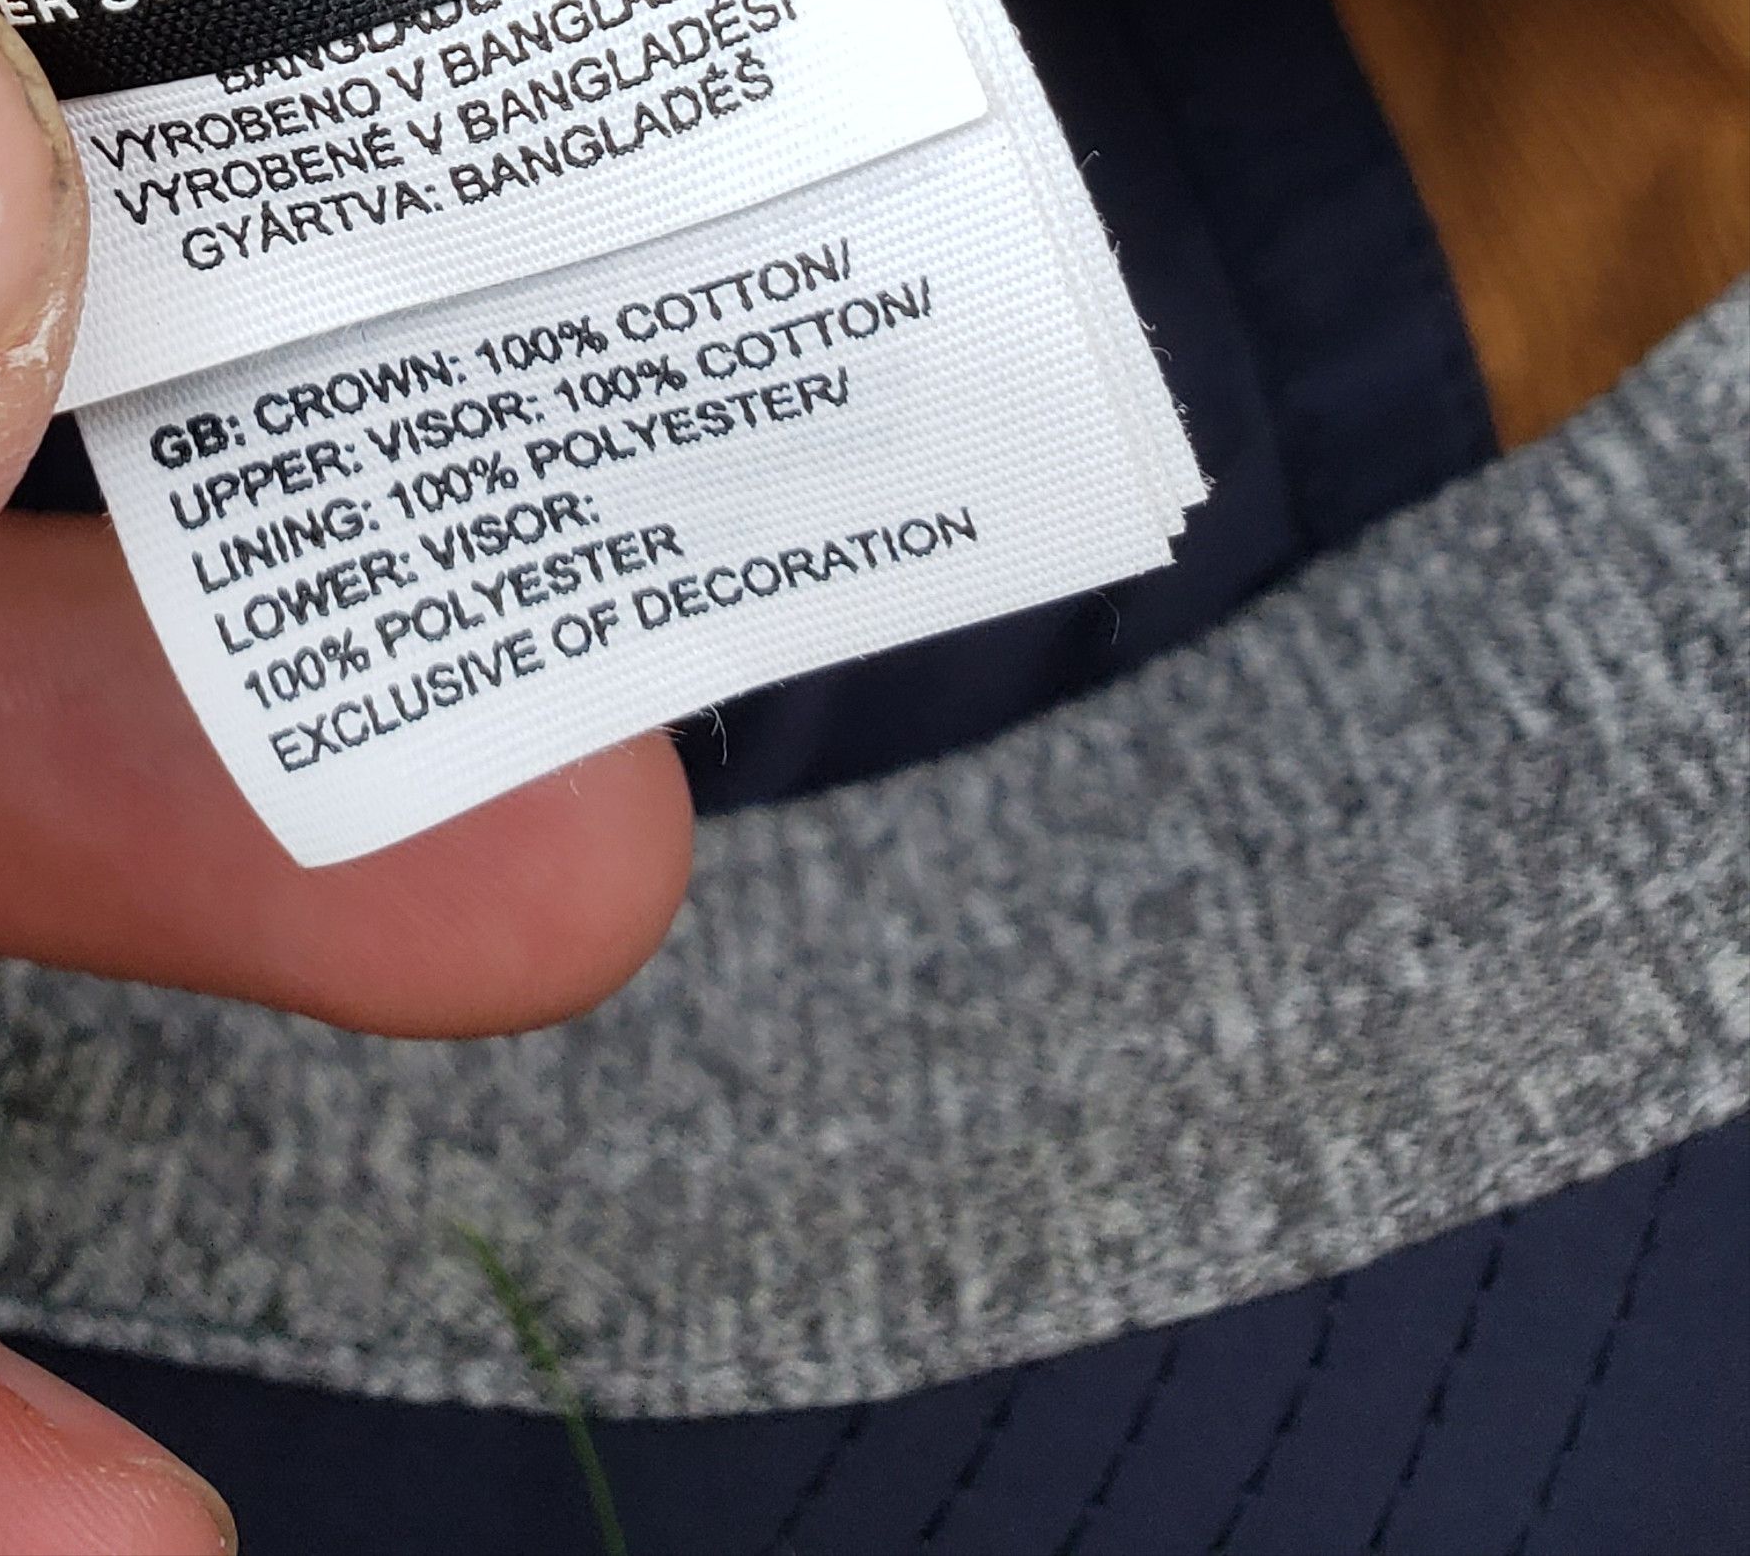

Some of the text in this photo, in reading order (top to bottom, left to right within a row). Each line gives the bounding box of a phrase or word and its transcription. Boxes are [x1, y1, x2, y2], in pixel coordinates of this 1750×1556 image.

[91, 76, 382, 170] VYROBENO
[387, 55, 427, 102] V
[113, 123, 405, 226] VYROBENÉ
[409, 112, 444, 155] V
[149, 237, 852, 471] GB: CROWN: 100% COTTON/
[171, 274, 933, 530] UPPER: VISOR: 100% COTTON/
[193, 367, 850, 594] LINING: 100% POLYESTER/
[214, 490, 600, 656] LOWER: VISOR:
[246, 523, 685, 710] 100% POLYESTER
[266, 506, 979, 773] EXCLUSIVE OF DECORATION
